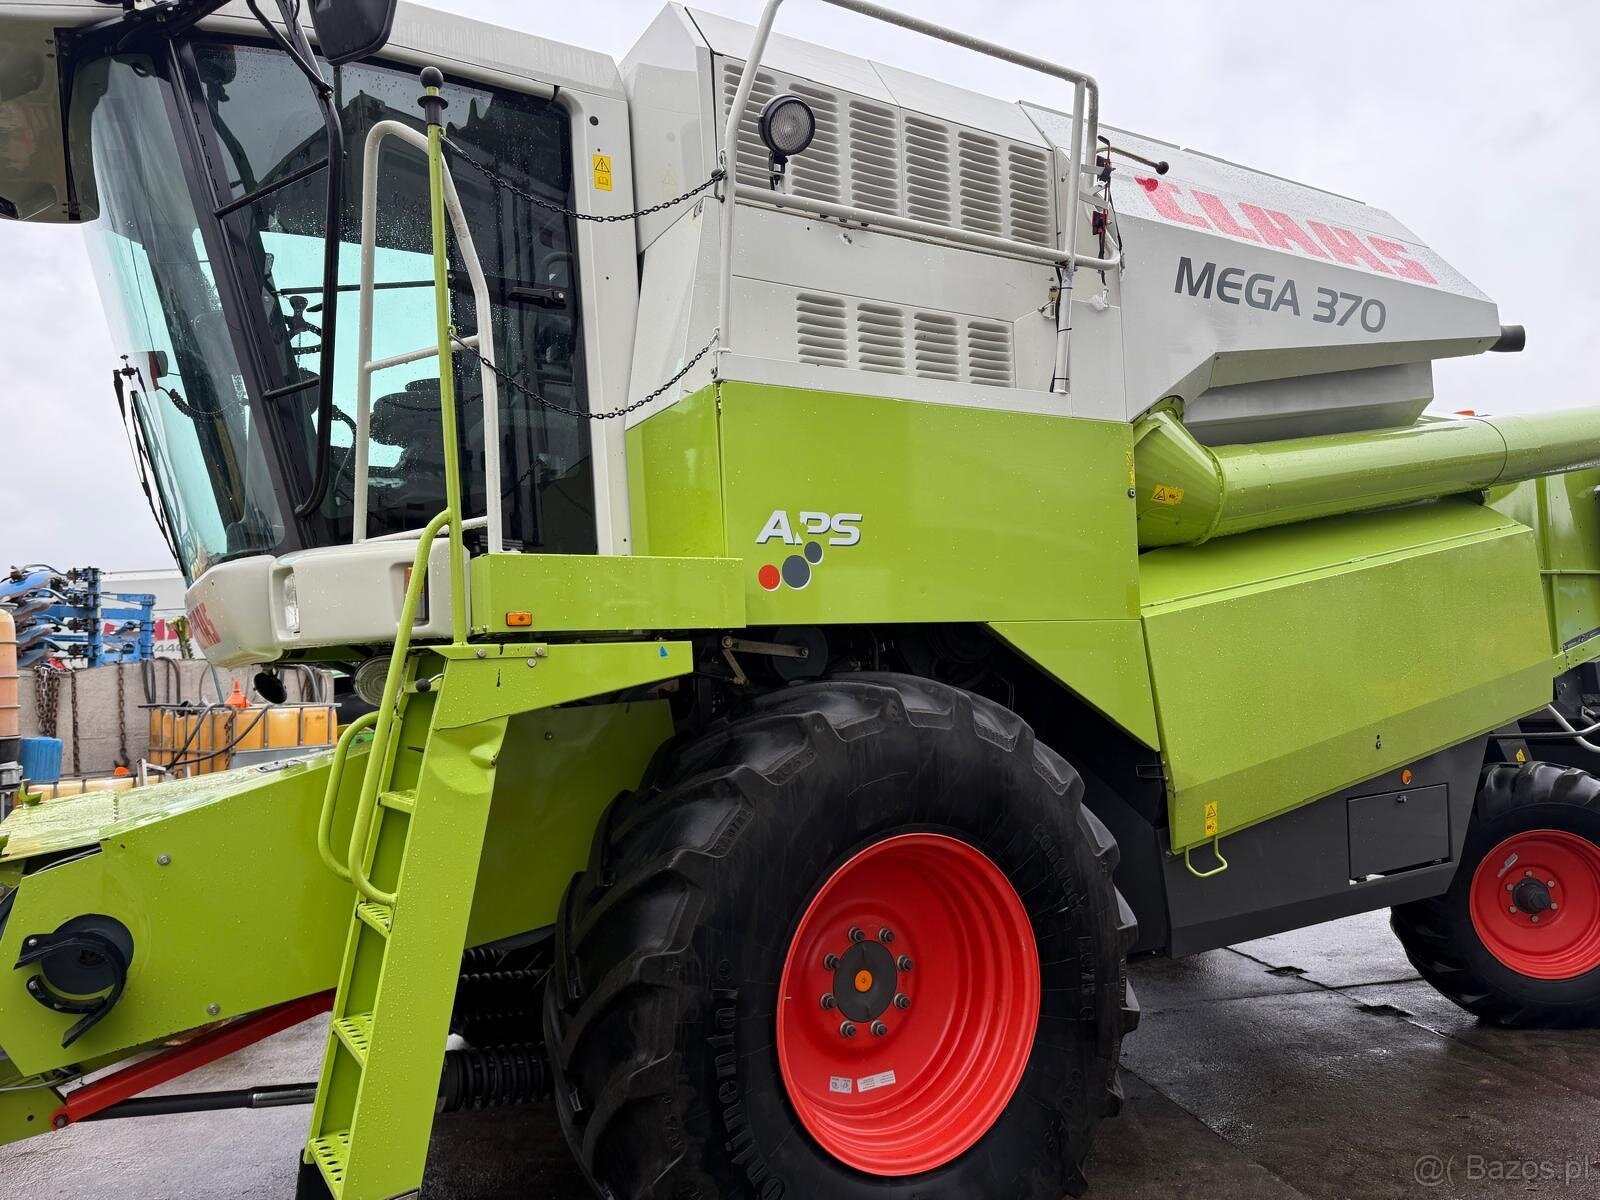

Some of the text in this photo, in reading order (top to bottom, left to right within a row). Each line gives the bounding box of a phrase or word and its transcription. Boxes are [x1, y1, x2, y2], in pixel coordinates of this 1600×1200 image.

[1135, 177, 1438, 284] CLAAS
[1175, 256, 1387, 333] MEGA 370
[755, 510, 863, 546] APS
[705, 987, 786, 1200] ontinental
